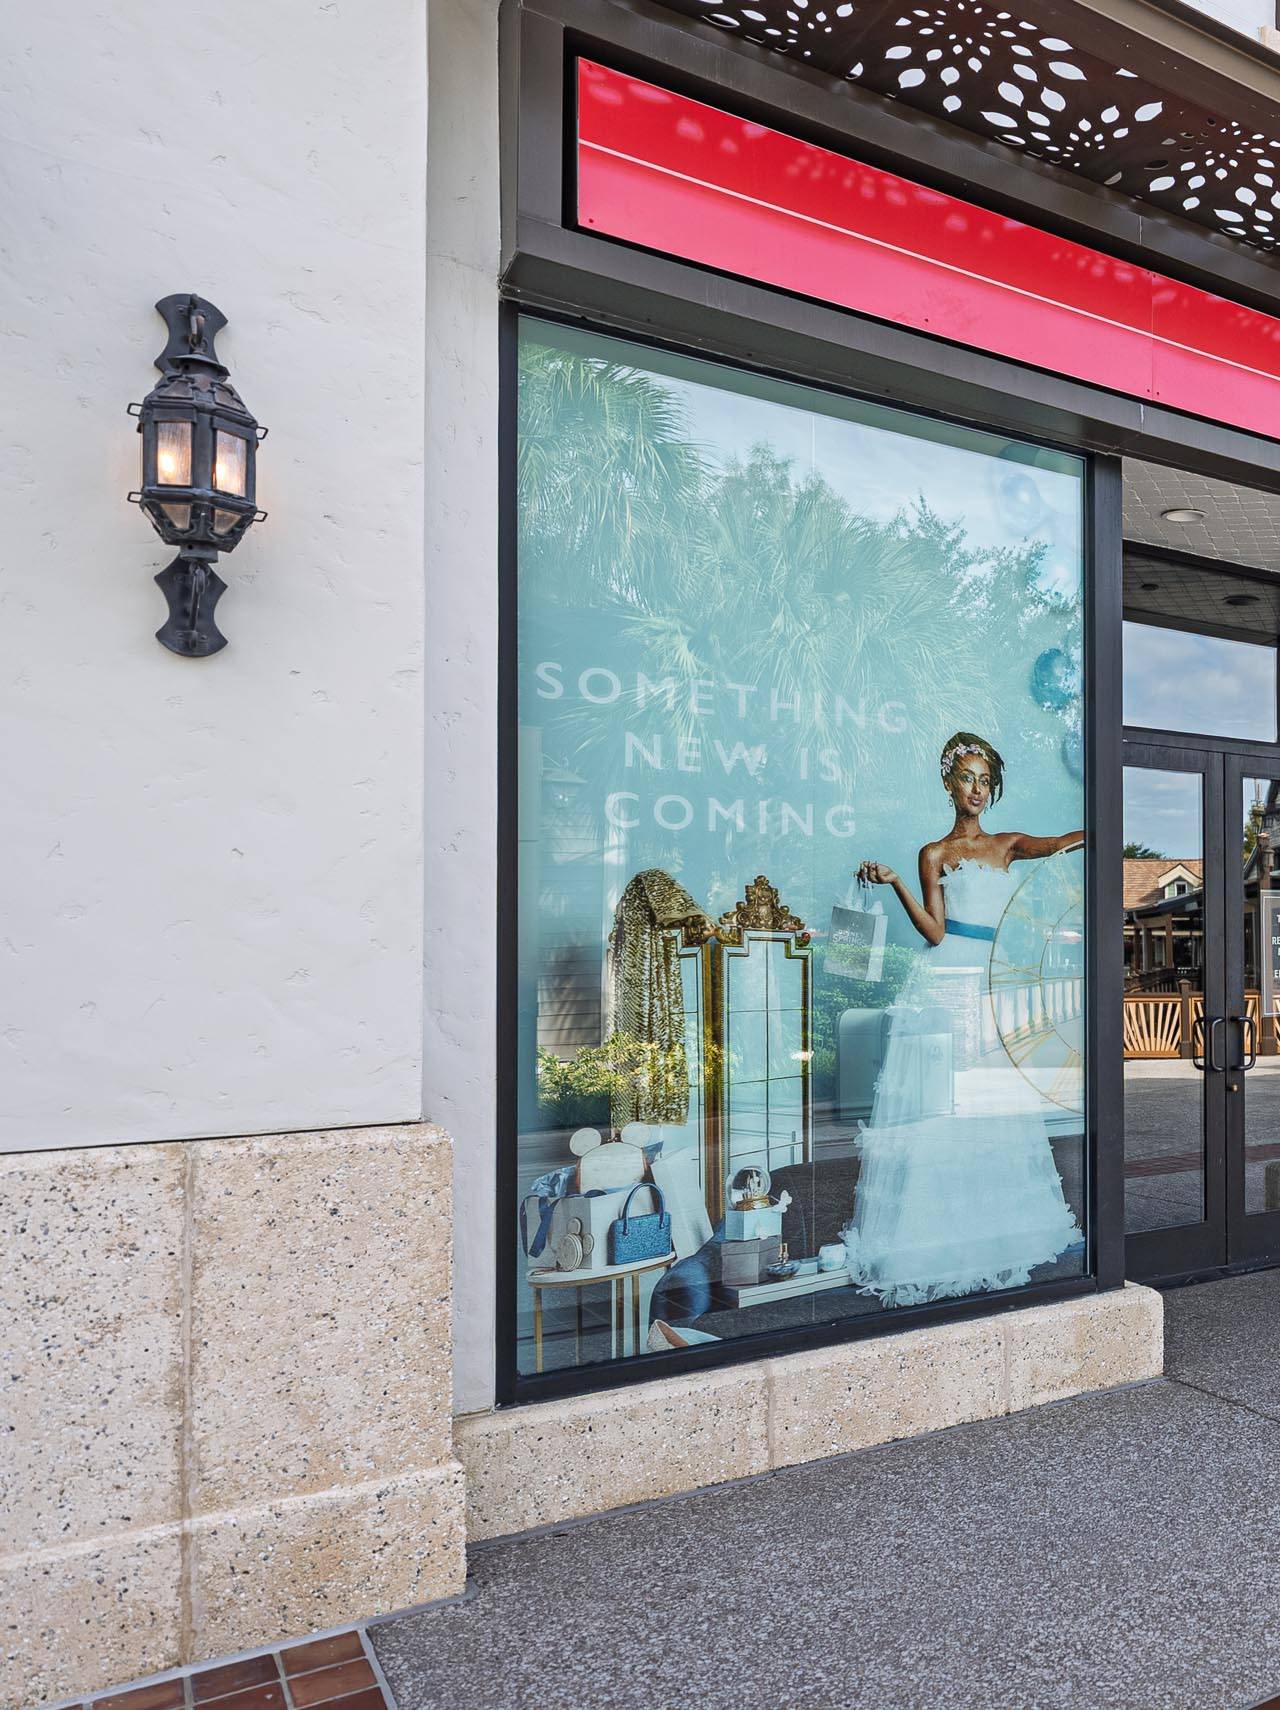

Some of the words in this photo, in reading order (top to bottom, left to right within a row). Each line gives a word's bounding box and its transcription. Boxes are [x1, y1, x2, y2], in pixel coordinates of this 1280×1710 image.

[535, 661, 908, 734] SOMETHING
[624, 731, 768, 777] NEW
[801, 748, 842, 782] IS
[604, 791, 858, 838] COMING
